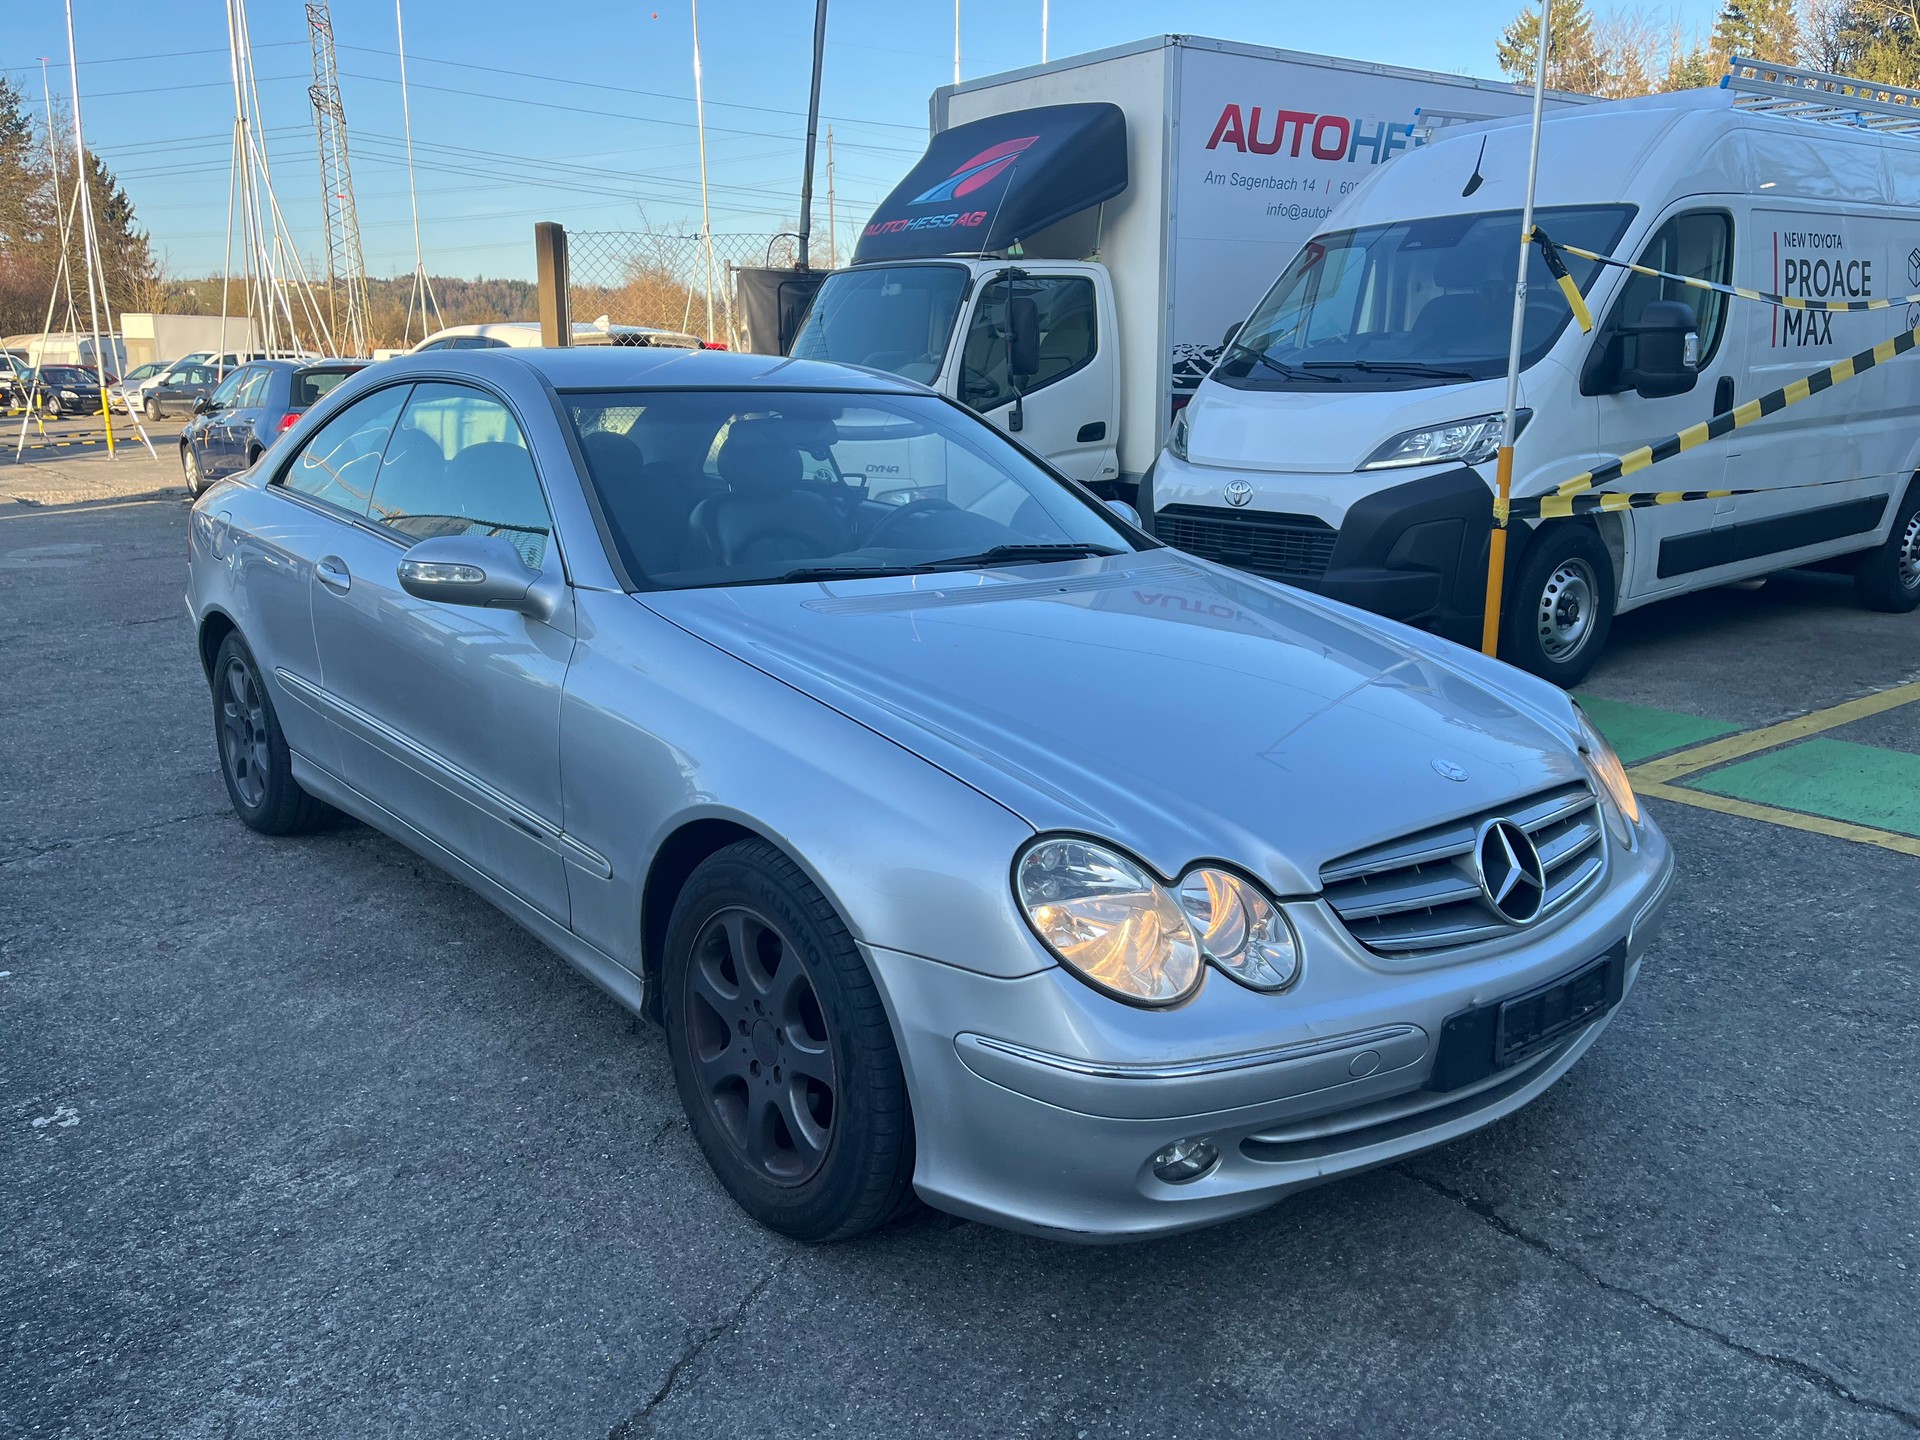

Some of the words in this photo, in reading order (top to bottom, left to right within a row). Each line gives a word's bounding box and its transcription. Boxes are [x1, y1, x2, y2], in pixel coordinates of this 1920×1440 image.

[1204, 170, 1226, 185] Am
[1229, 172, 1298, 191] Sagenbach
[1302, 178, 1316, 192] 14
[1784, 232, 1806, 248] NEW
[1808, 233, 1843, 249] TOYOTA
[1785, 259, 1871, 297] PROACE
[1782, 309, 1833, 348] MAX
[865, 464, 900, 474] DYNA
